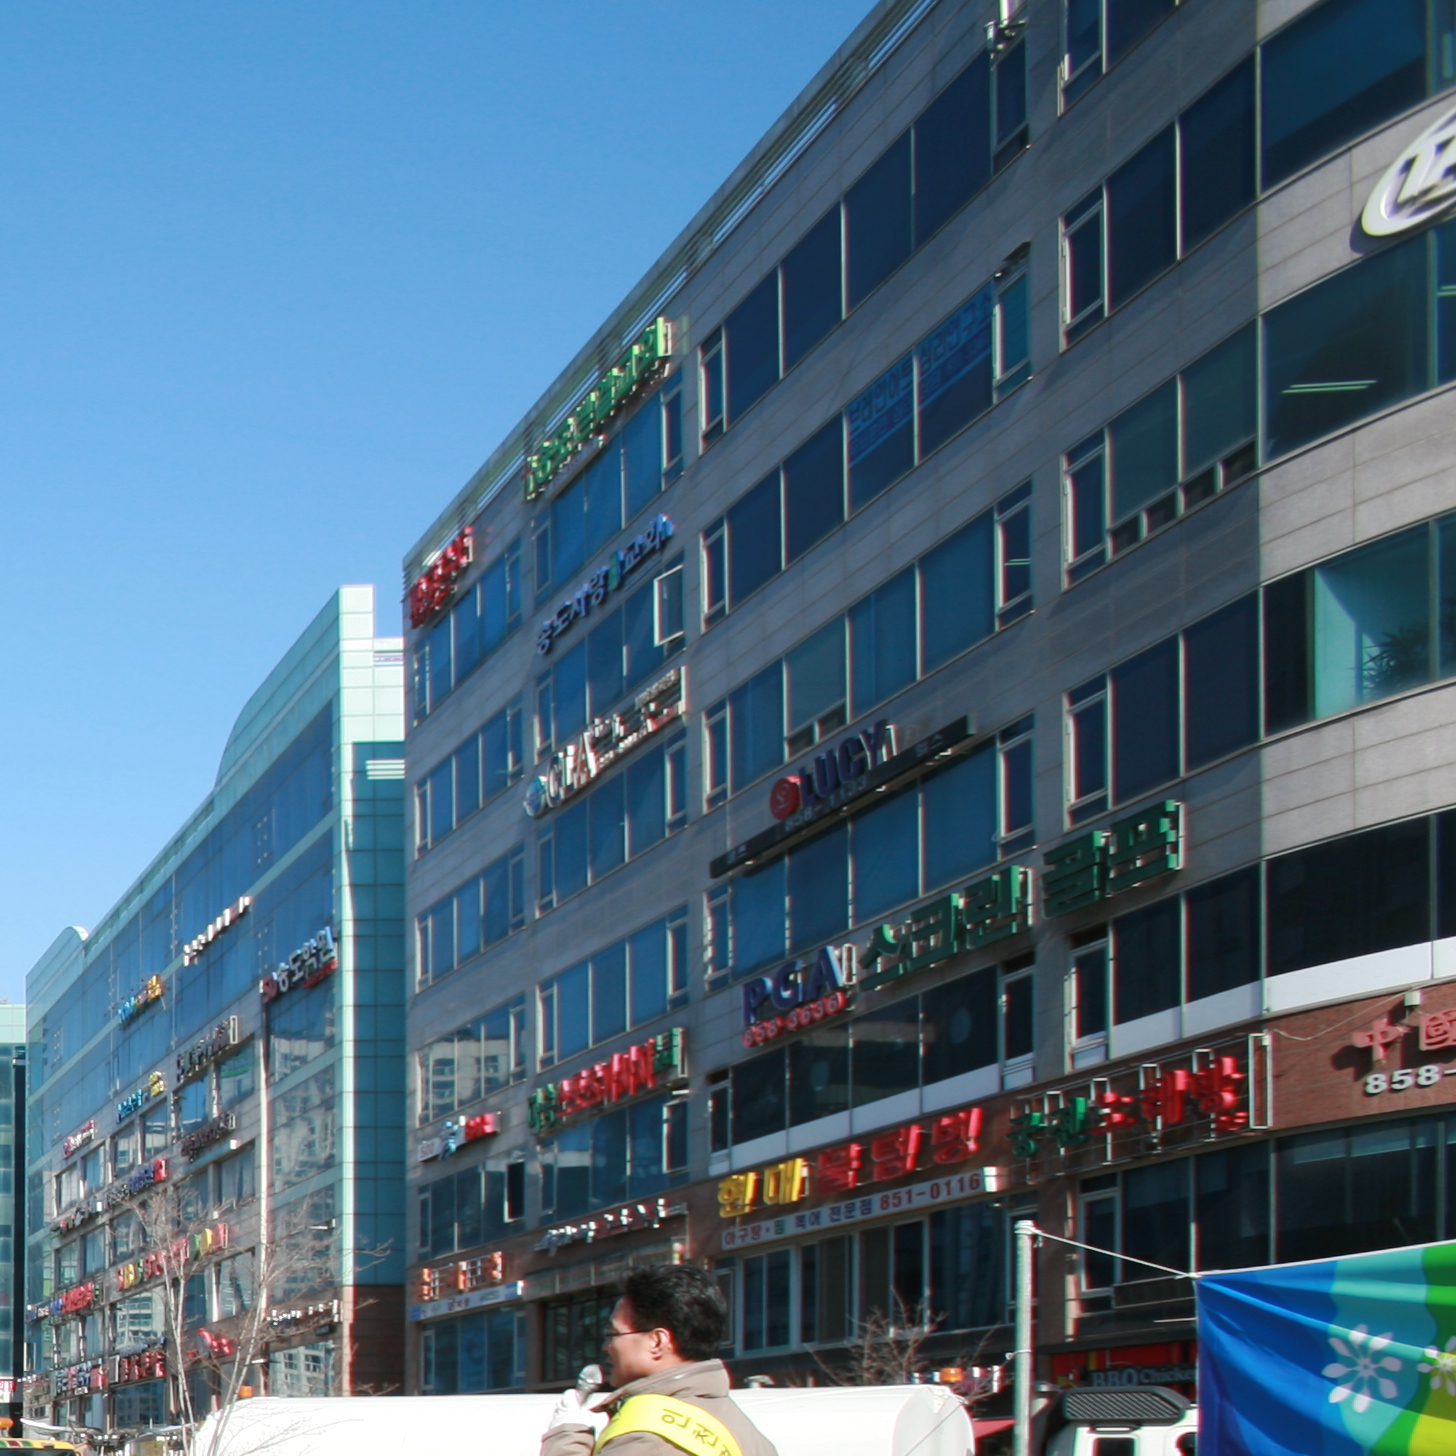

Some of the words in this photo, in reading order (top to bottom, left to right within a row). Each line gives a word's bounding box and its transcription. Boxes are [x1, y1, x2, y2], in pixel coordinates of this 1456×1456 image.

[798, 720, 888, 809] LUCY
[743, 945, 845, 1027] PGA
[860, 865, 1033, 991] 스크린
[743, 992, 847, 1048] 858-3636
[1365, 1063, 1456, 1096] 858-
[879, 1175, 981, 1211] 851-0116
